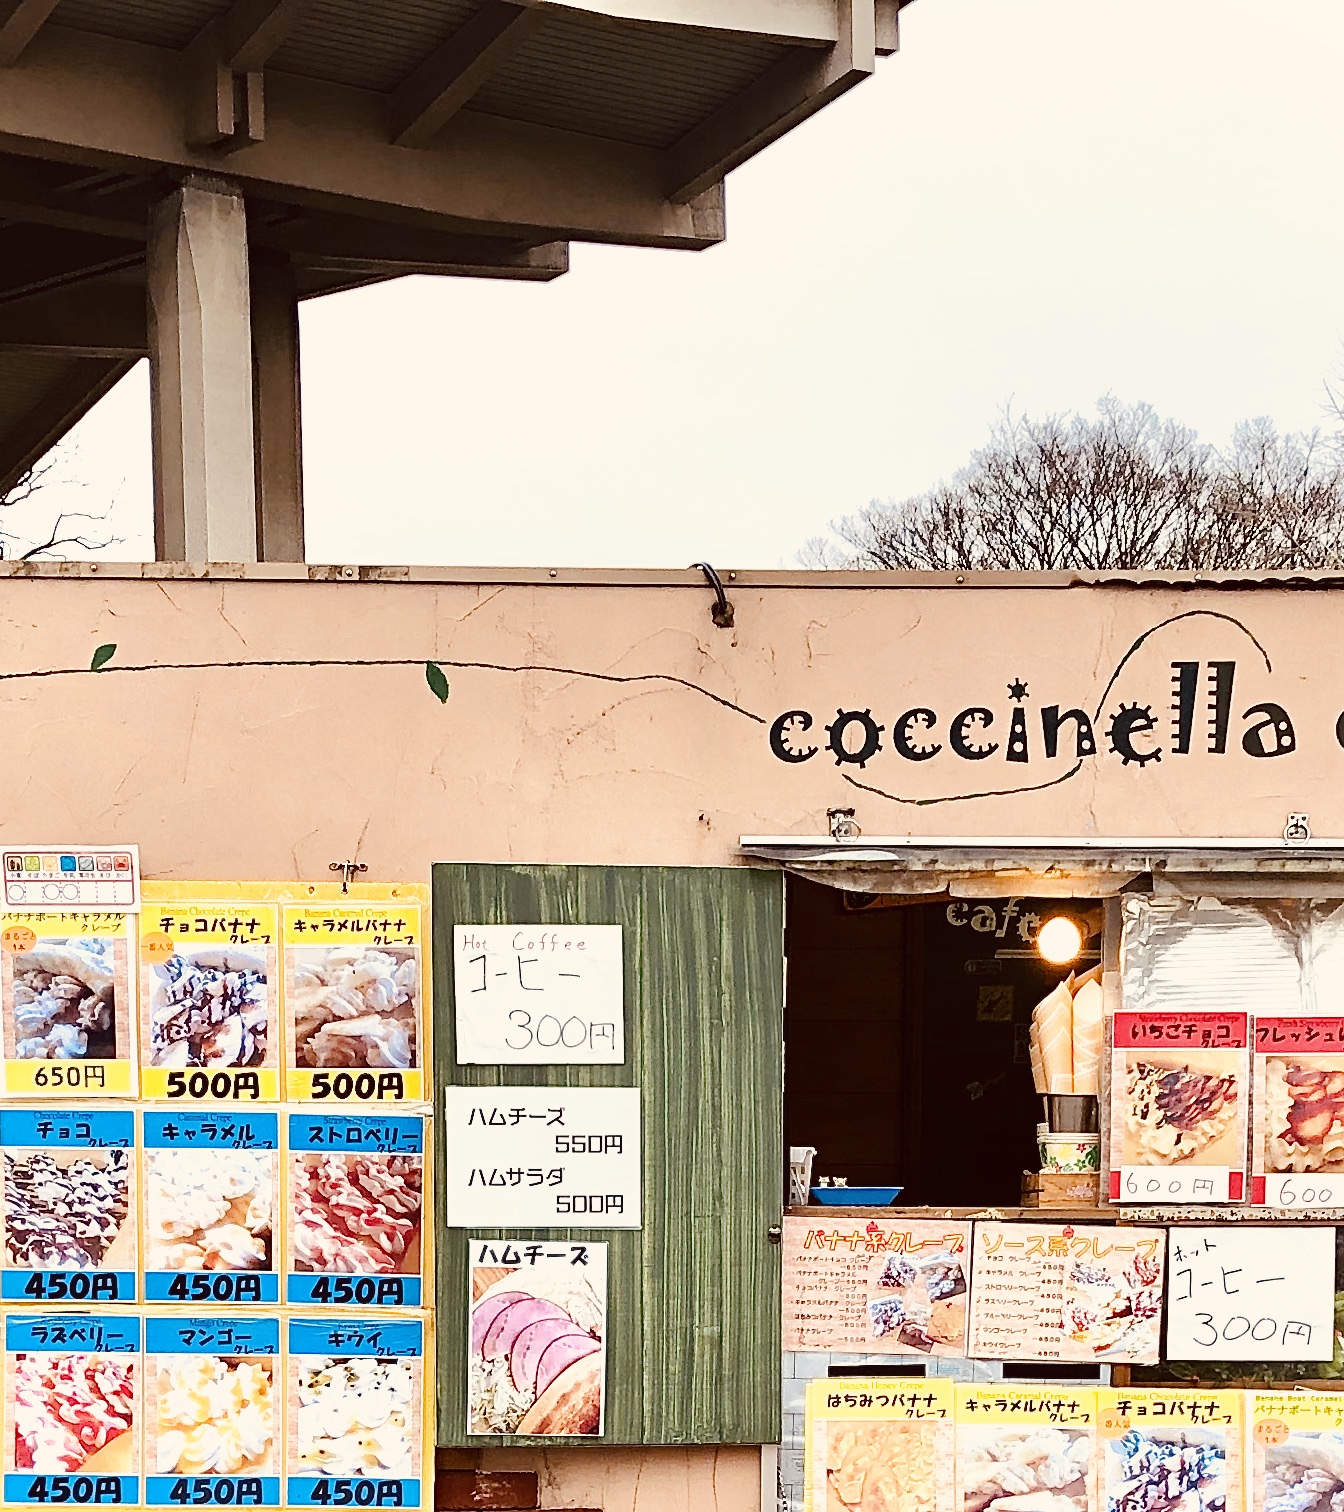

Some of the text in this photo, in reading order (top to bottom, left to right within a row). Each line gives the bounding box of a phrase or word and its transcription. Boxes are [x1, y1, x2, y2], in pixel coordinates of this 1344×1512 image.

[769, 661, 1298, 768] coccinella
[2, 912, 126, 922] バナナボートキャラメル
[159, 918, 261, 933] チョコバナナ
[293, 919, 406, 933] キャラメルバナナ
[81, 923, 121, 933] クレープ
[229, 935, 271, 944] クレープ
[373, 936, 414, 945] クレープ
[463, 931, 586, 951] Hot Coffee
[469, 955, 580, 993] コーヒー
[505, 1009, 615, 1050] 300円
[1130, 1025, 1231, 1040] いちごチョコ
[34, 1065, 105, 1088] 650円
[167, 1072, 259, 1099] 500円
[311, 1072, 404, 1100] 500円
[468, 1107, 565, 1126] ハムチーズ
[36, 1122, 91, 1139] チョコ
[162, 1123, 256, 1141] キャラメル
[308, 1126, 419, 1144] ストロベリー
[88, 1138, 129, 1148] クレープ
[231, 1139, 273, 1149] クレープ
[376, 1144, 418, 1153] クレープ
[555, 1135, 623, 1154] 550円
[468, 1167, 565, 1186] ハムサラダ
[1125, 1171, 1213, 1195] 600円
[556, 1195, 624, 1213] 500円
[803, 1230, 964, 1254] バナナ系クレープ
[982, 1233, 1158, 1261] ソース系クレープ
[478, 1244, 589, 1266] ハムチーズ
[25, 1272, 119, 1300] 450円
[168, 1273, 261, 1301] 450円
[311, 1277, 404, 1305] 450円
[1176, 1266, 1285, 1301] コーヒー
[31, 1326, 124, 1344] ラズベリー
[178, 1329, 252, 1347] マンゴー
[1193, 1313, 1312, 1346] 300円
[94, 1343, 135, 1353] クレープ
[328, 1331, 383, 1349] キウイ
[234, 1345, 275, 1355] クレープ
[376, 1347, 417, 1356] クレープ
[827, 1393, 937, 1408] はちみつバナナ
[965, 1399, 1080, 1413] キャラメルバナナ
[1117, 1401, 1220, 1416] チョコバナナ
[905, 1409, 946, 1418] クレープ
[1049, 1413, 1090, 1422] クレープ
[1190, 1415, 1232, 1424] クレープ
[1103, 1420, 1131, 1429] 番人気
[1257, 1424, 1289, 1434] まるごと
[28, 1476, 121, 1504] 450円
[169, 1478, 263, 1505] 450円
[311, 1479, 403, 1506] 450円
